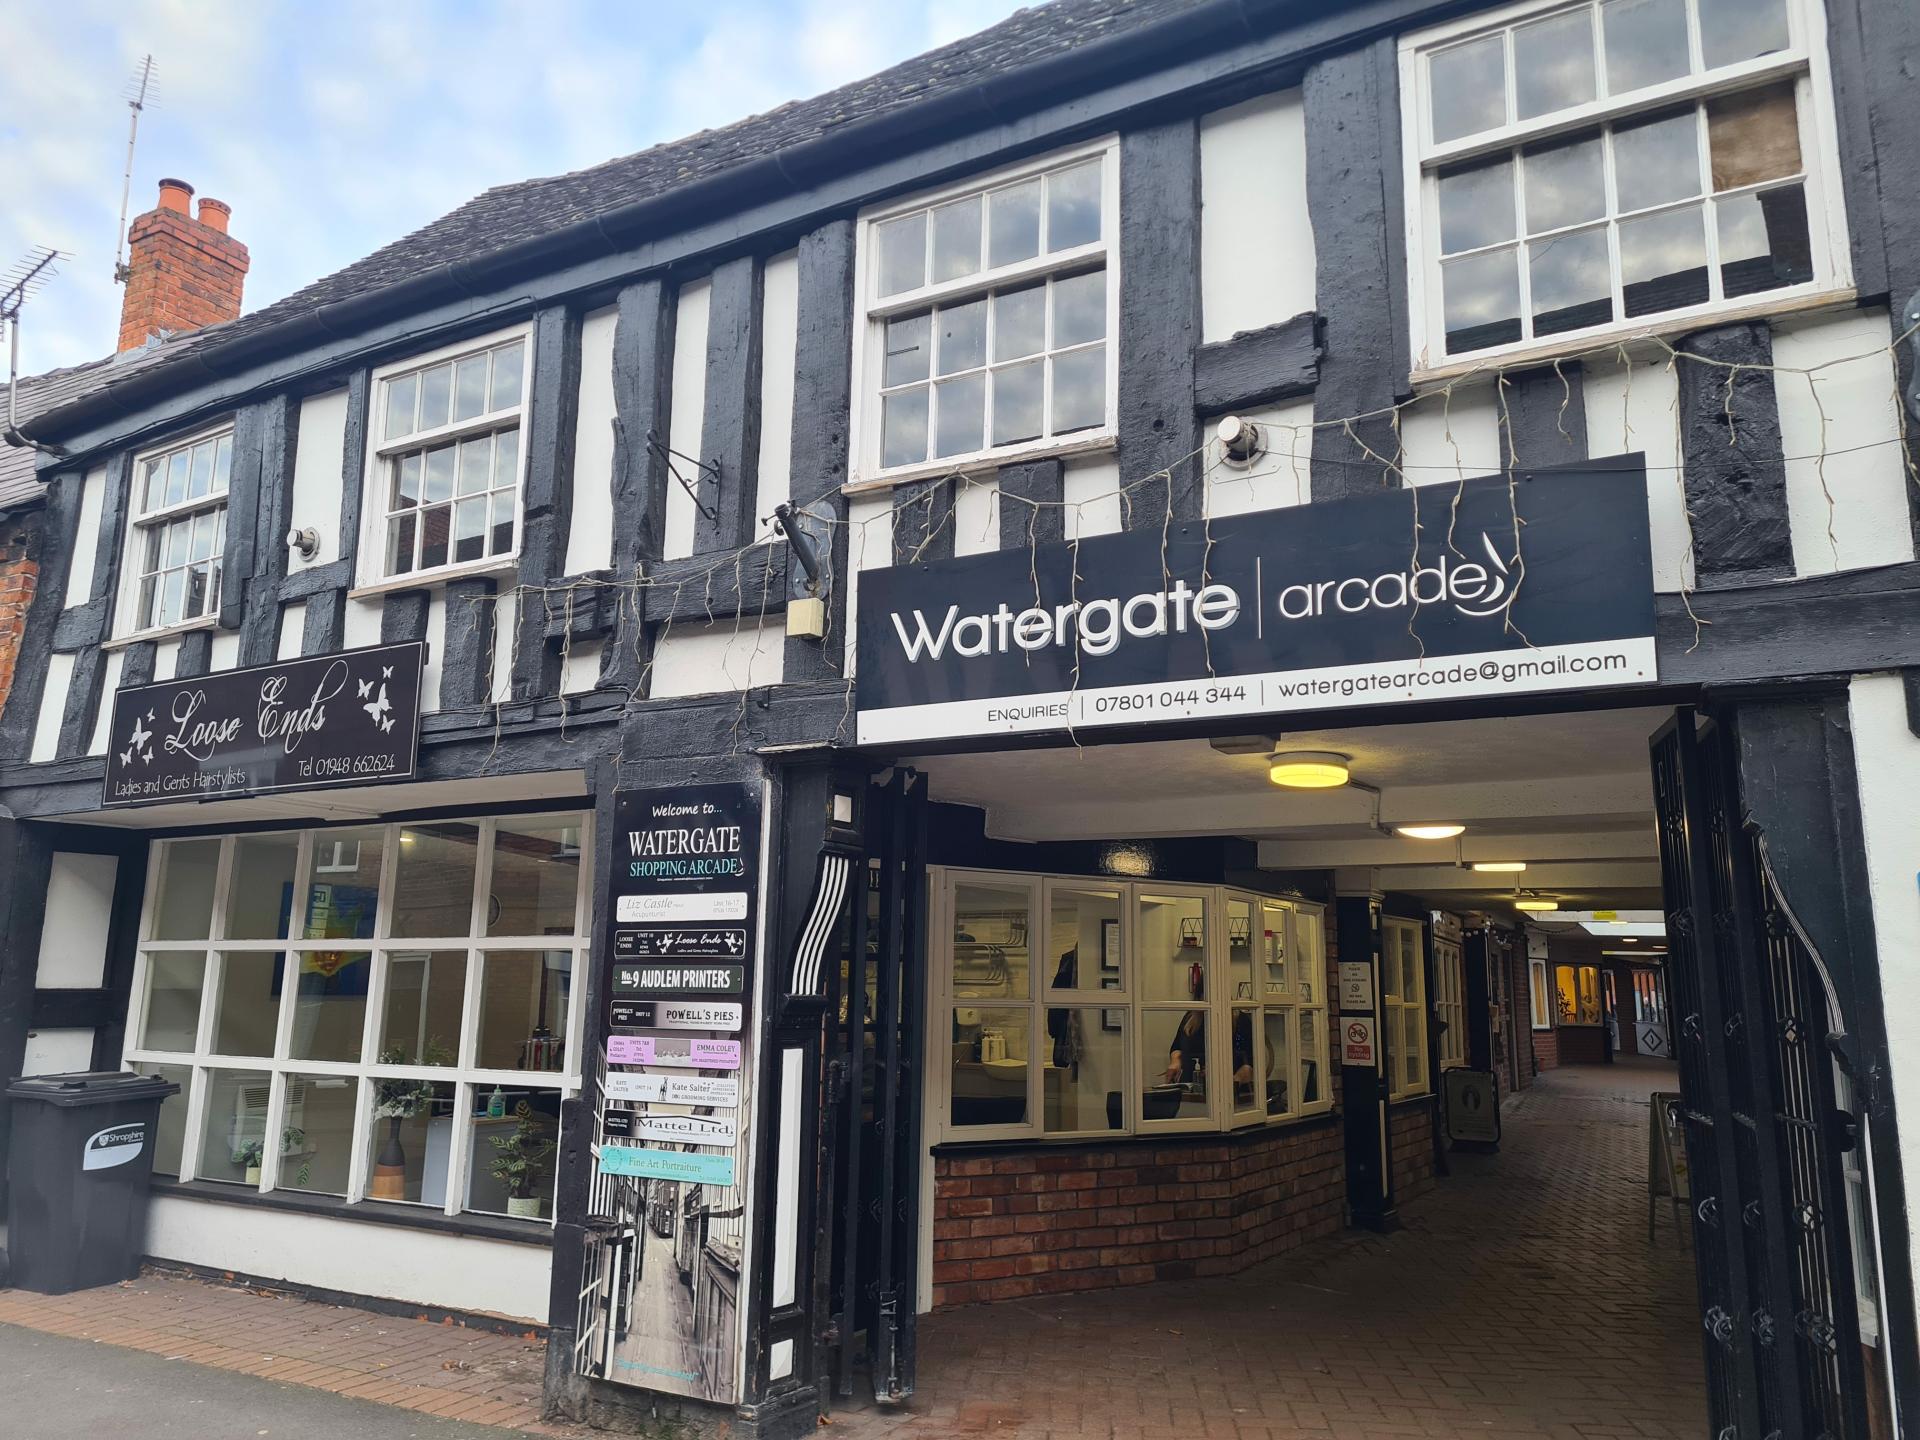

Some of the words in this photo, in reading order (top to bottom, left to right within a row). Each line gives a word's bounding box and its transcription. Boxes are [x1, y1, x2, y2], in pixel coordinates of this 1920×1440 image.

[891, 579, 1241, 663] Watergate
[1279, 555, 1488, 620] arcade
[988, 702, 1068, 722] ENQUIRIES
[1095, 693, 1154, 714] 07801
[1160, 690, 1199, 708] 044
[1206, 686, 1247, 705] 344
[1278, 652, 1627, 698] watergatearcade@gmail.com
[164, 689, 244, 762] Loose
[258, 659, 349, 754] Ends
[298, 758, 312, 777] Tel
[316, 757, 350, 776] 01948
[353, 754, 395, 773] 662624
[115, 777, 141, 797] Ladies
[144, 774, 160, 794] and
[163, 774, 190, 792] Gents
[193, 767, 246, 791] Hairstylists
[652, 803, 698, 818] Welcome
[628, 826, 741, 857] WATERGATE
[630, 859, 686, 877] SHOPPING
[689, 858, 737, 876] ARCADE
[626, 898, 641, 910] Liz
[644, 897, 673, 910] Castle
[675, 932, 697, 945] Loose
[700, 932, 722, 945] Ends
[640, 969, 681, 988] AUDLEM
[683, 970, 731, 989] PRINTERS
[666, 1009, 711, 1021] POWELL'S
[714, 1011, 734, 1021] PIES
[696, 1044, 715, 1053] EMMA
[672, 1082, 688, 1091] Kate
[689, 1083, 711, 1093] Salter
[638, 1118, 693, 1132] Mattel
[109, 1131, 145, 1143] Shropshire
[628, 1156, 645, 1167] Fine
[647, 1157, 659, 1168] Art
[662, 1160, 702, 1173] Portraiture
